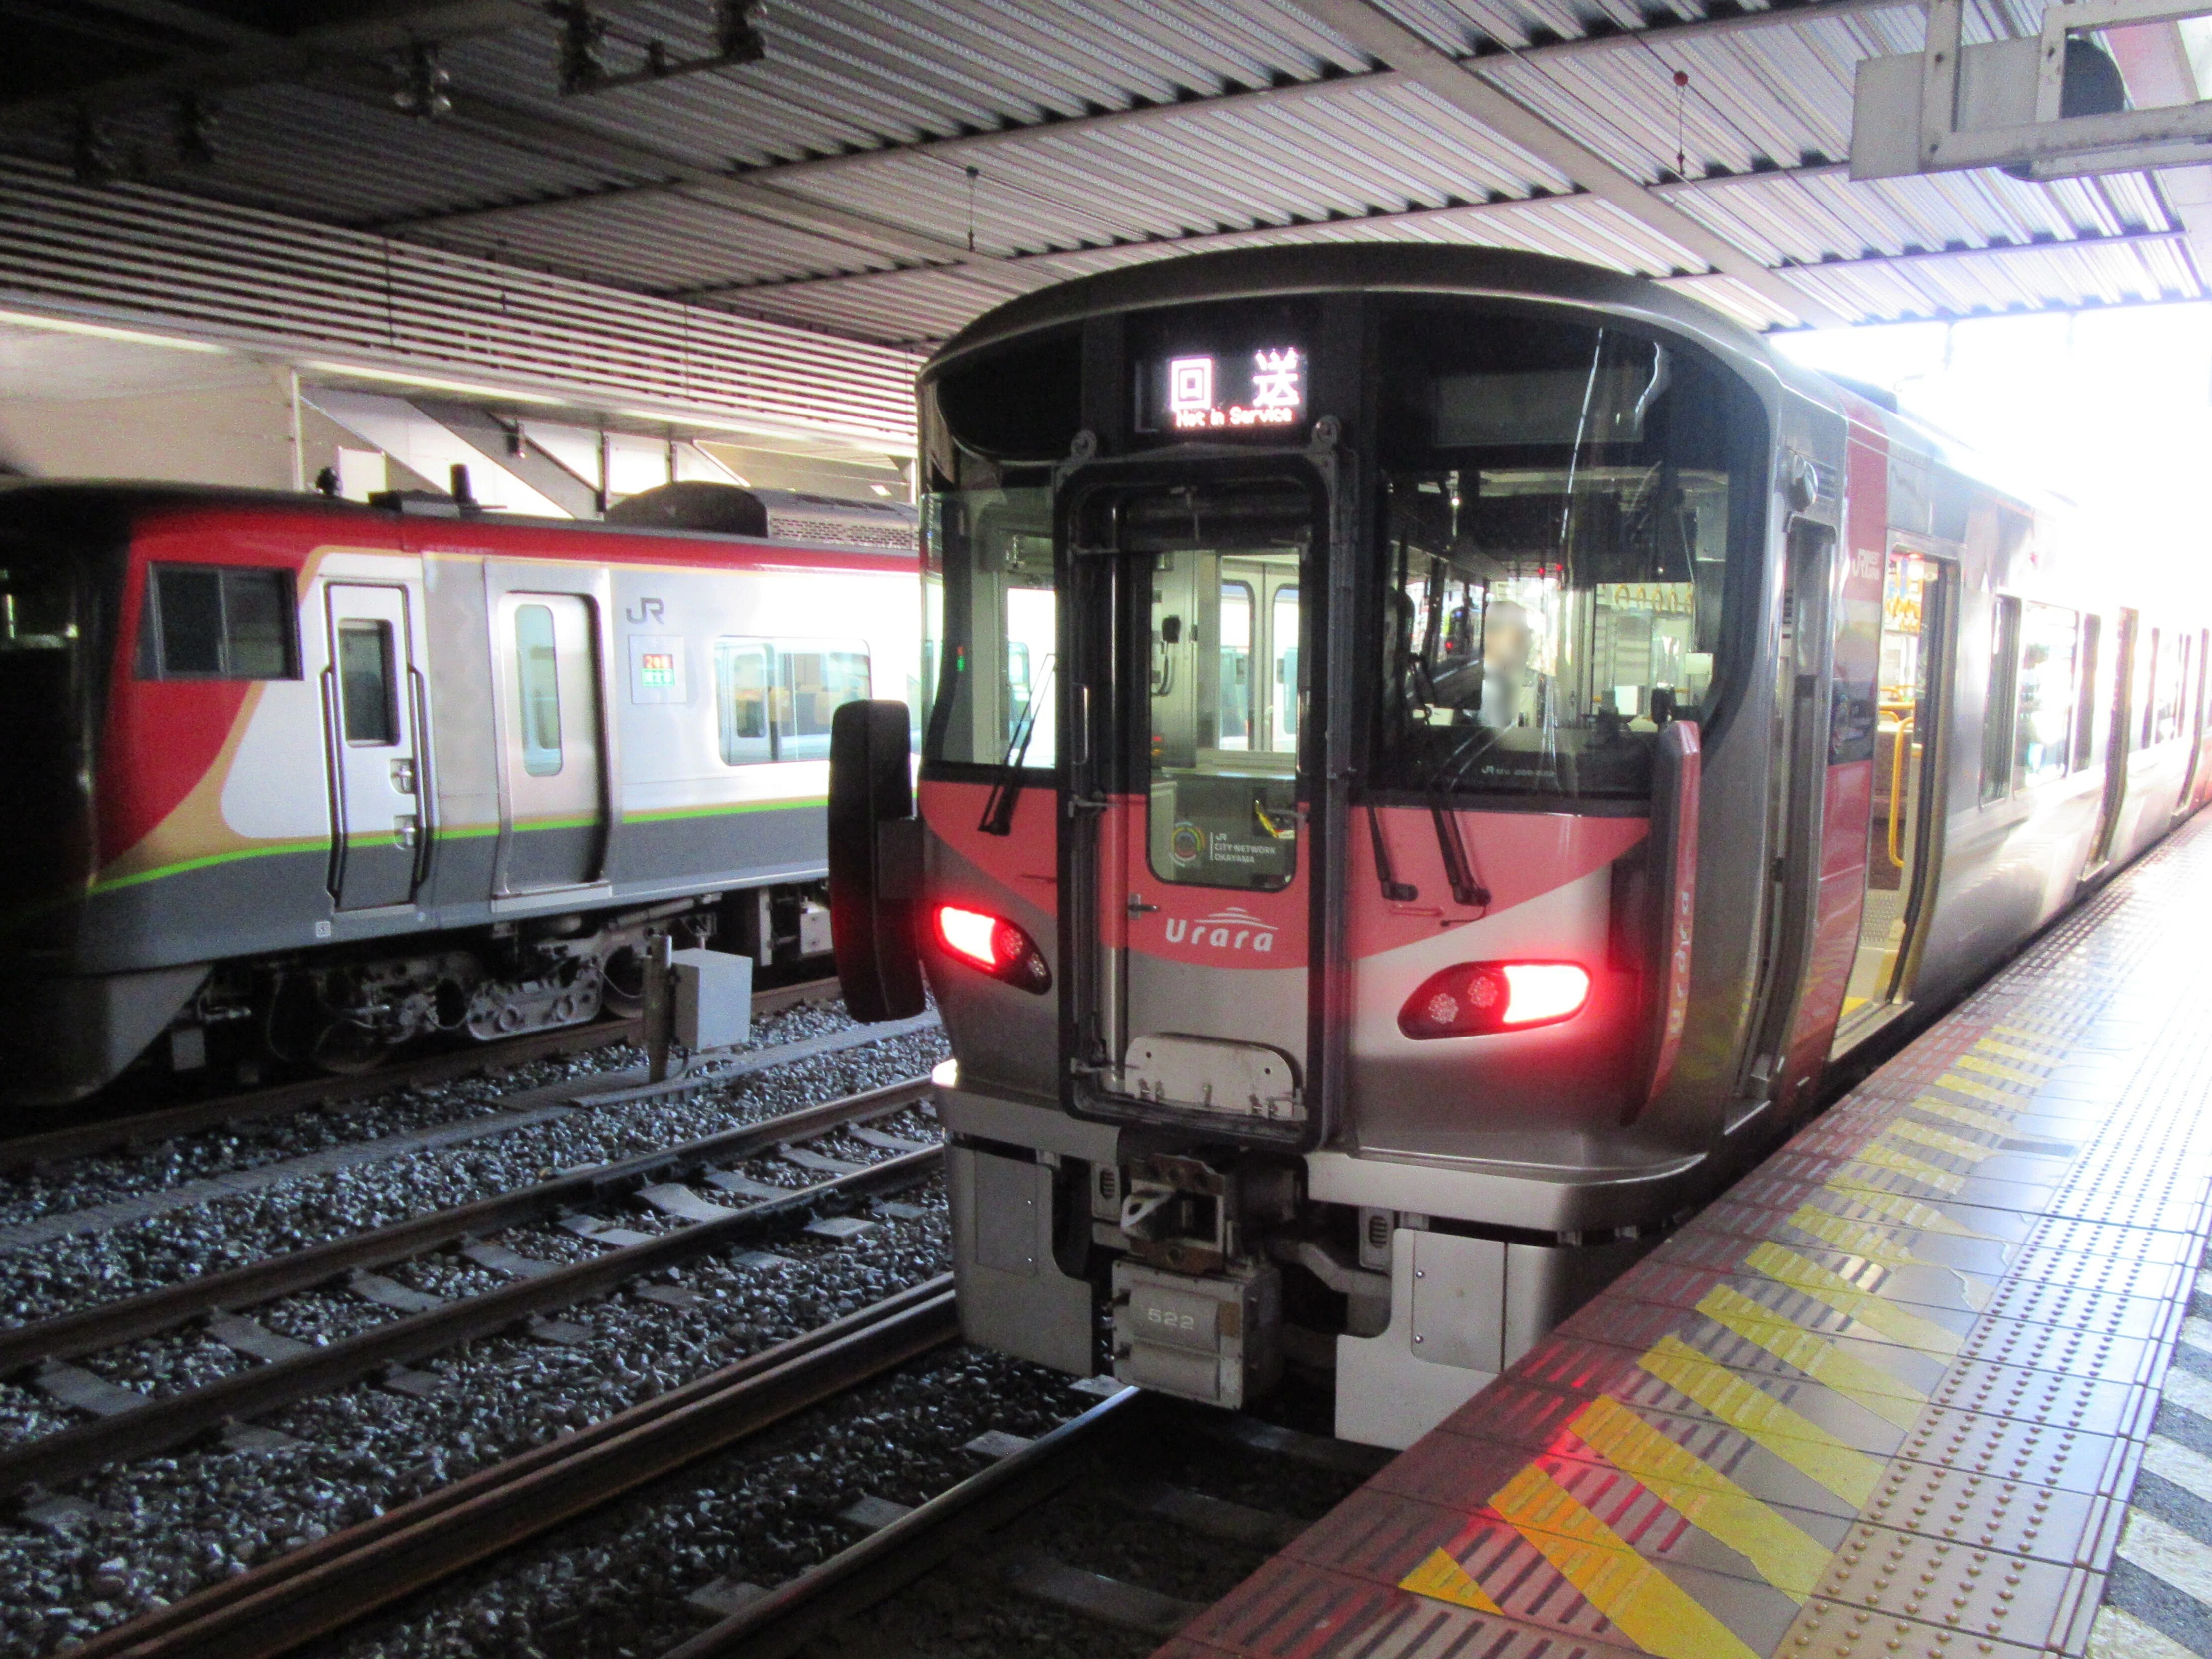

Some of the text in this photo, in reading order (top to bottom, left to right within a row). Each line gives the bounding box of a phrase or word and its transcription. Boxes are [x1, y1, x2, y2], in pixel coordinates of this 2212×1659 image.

[1170, 347, 1302, 411] 回送
[1176, 406, 1292, 427] Not in Service
[626, 597, 664, 624] JR
[1165, 918, 1274, 952] Urara
